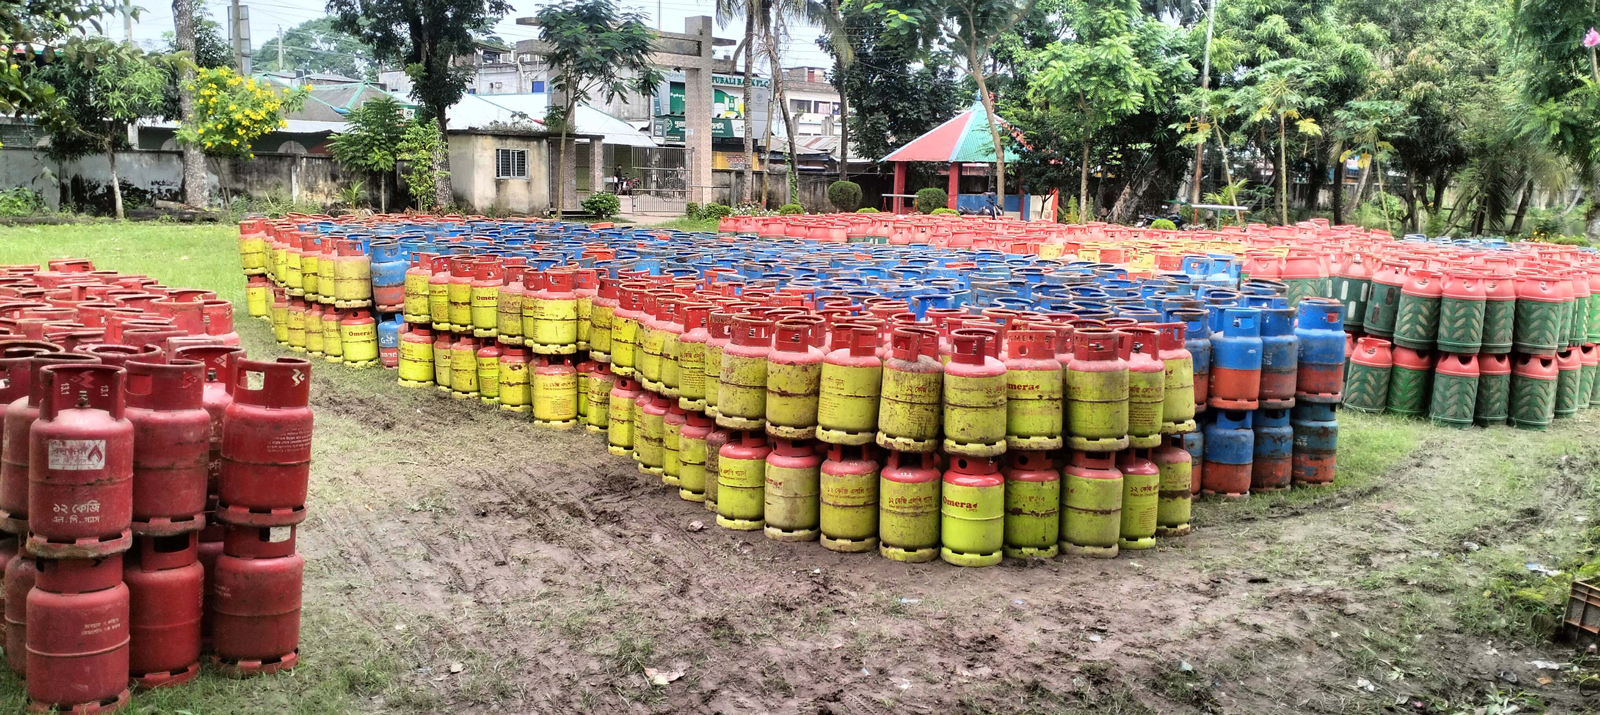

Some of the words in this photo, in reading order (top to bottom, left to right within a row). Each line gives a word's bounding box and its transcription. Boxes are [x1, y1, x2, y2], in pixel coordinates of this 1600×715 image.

[737, 78, 754, 86] BAK
[53, 503, 68, 514] ১২
[72, 500, 100, 513] কেজি
[943, 496, 972, 508] Omera
